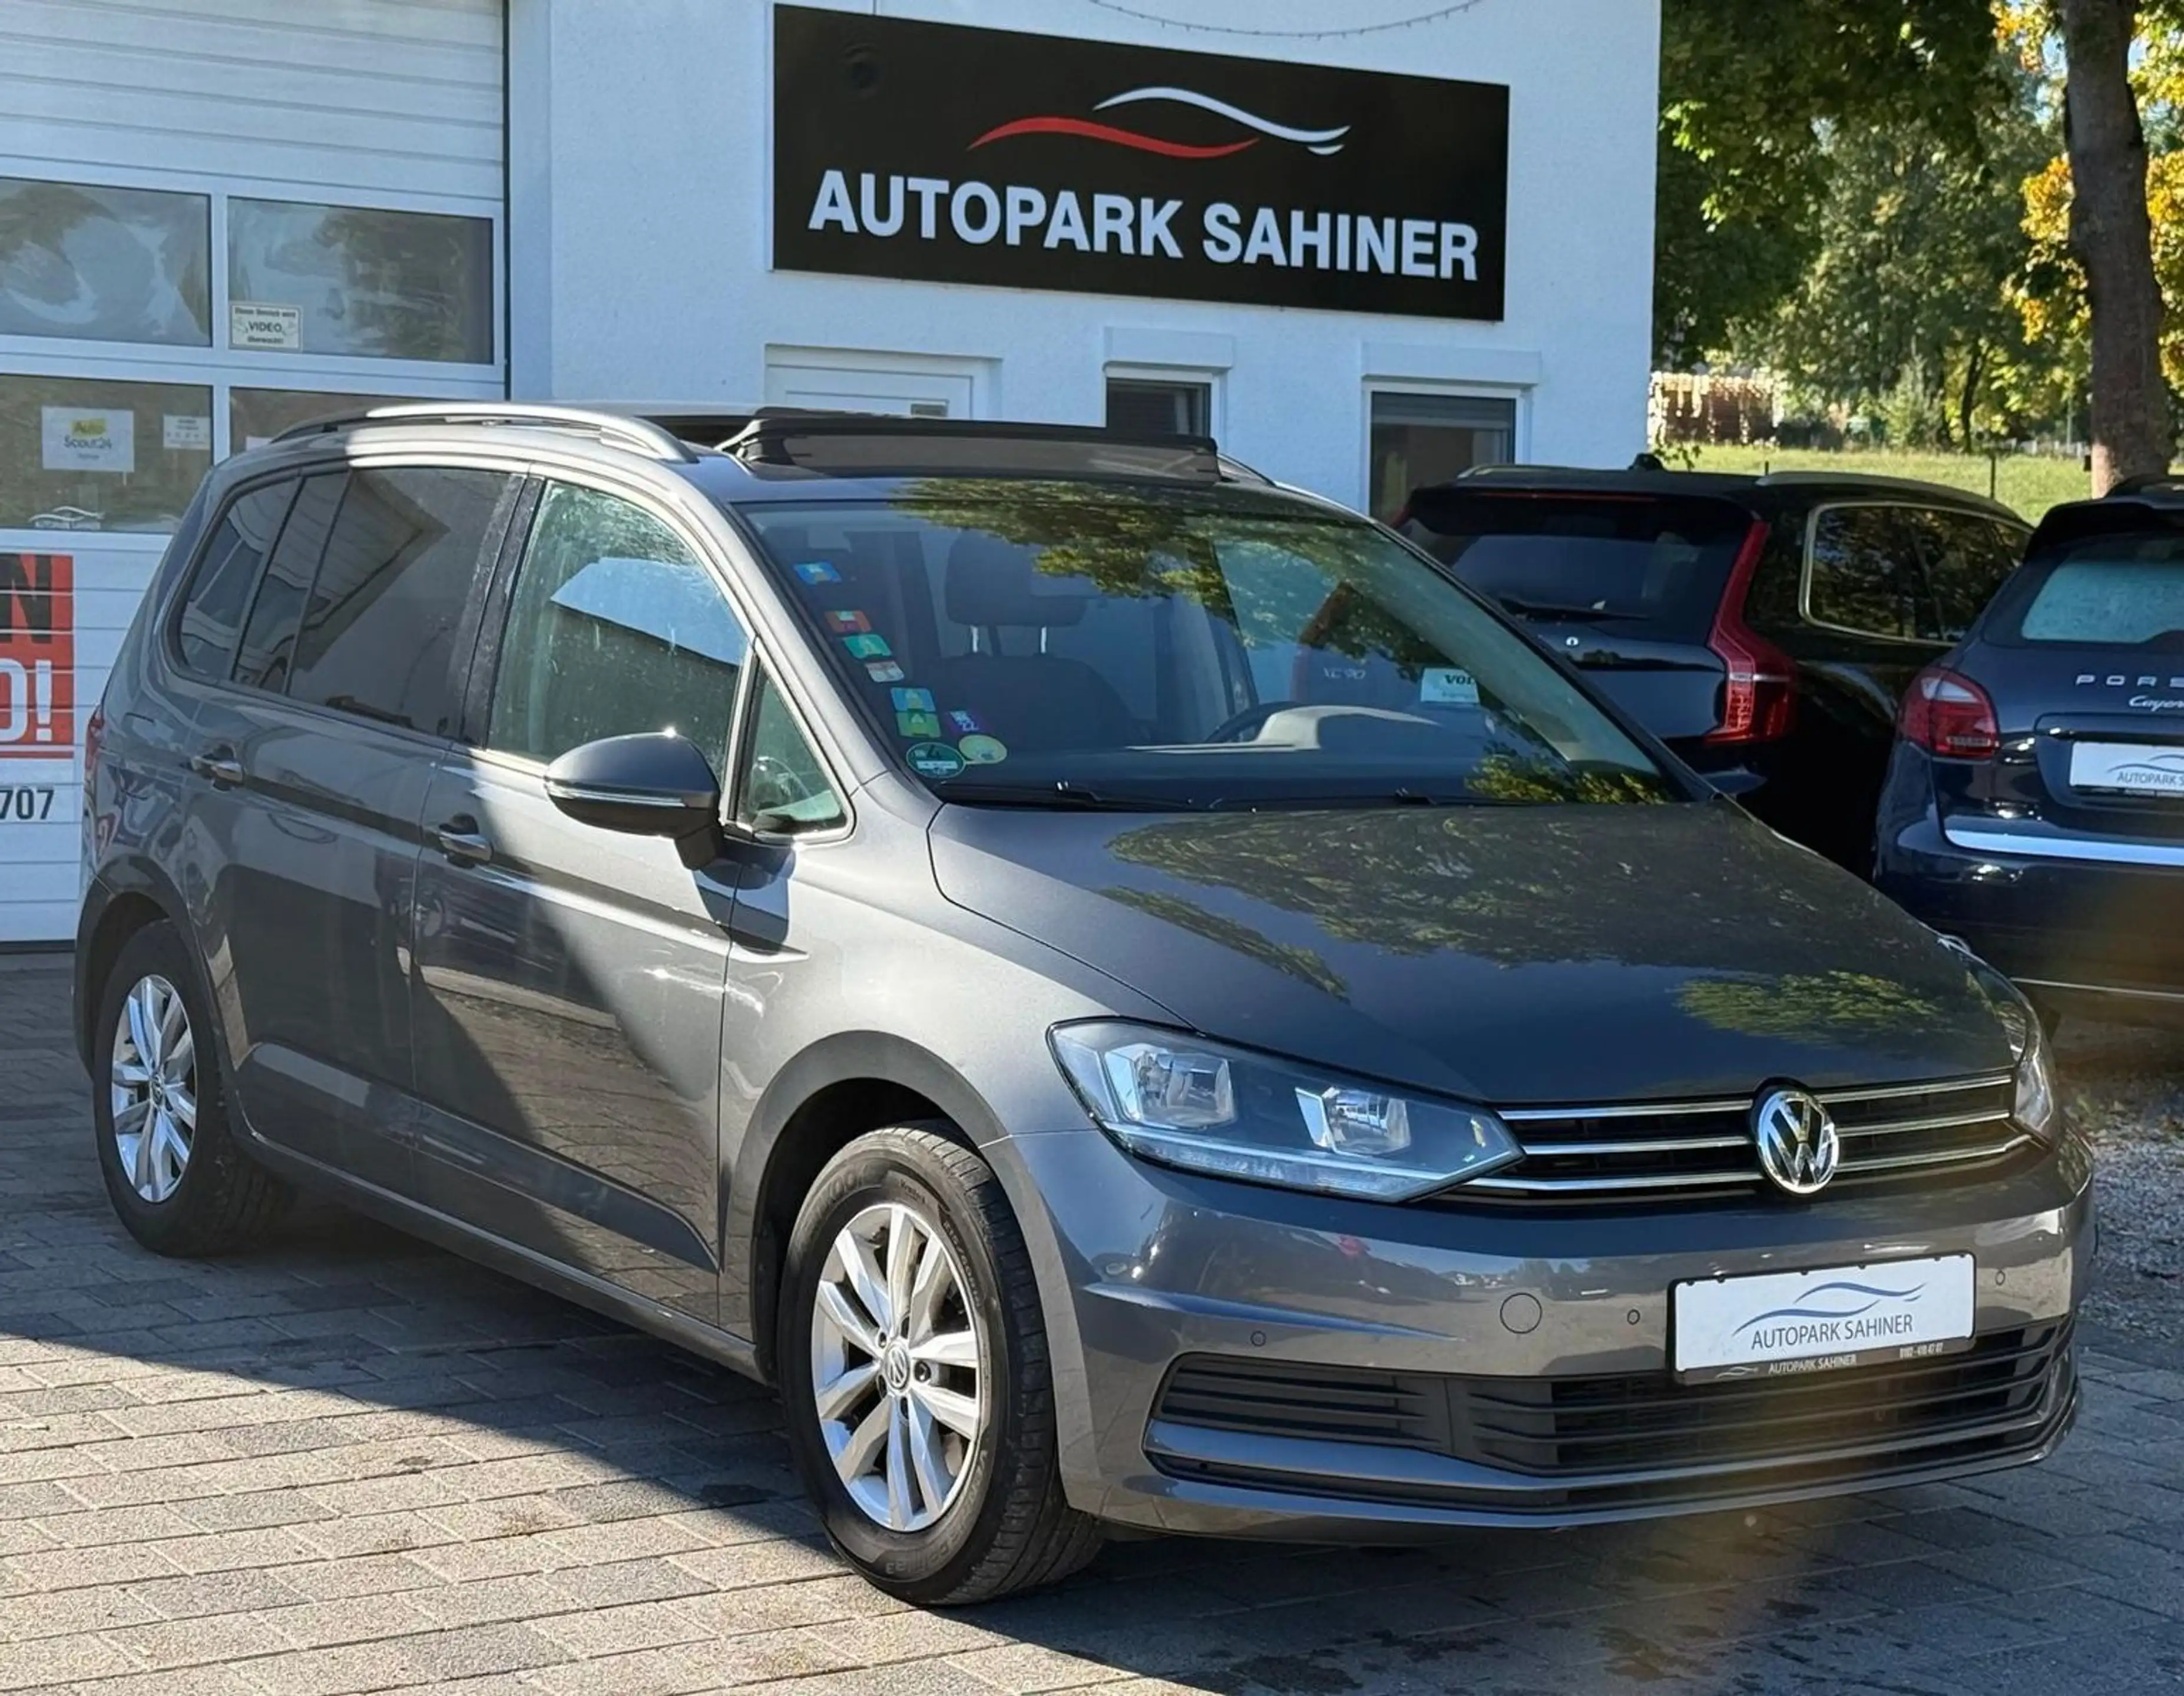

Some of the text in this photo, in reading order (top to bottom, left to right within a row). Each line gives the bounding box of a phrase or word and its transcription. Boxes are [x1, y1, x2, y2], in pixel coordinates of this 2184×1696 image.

[808, 169, 1478, 281] AUTOPARK SAHINER
[248, 320, 283, 333] VIDEO
[2116, 771, 2177, 786] AUTOPARK
[1751, 1314, 1913, 1350] AUTOPARK SAHINER
[1768, 1354, 1857, 1375] AUTOPARK SAHINER
